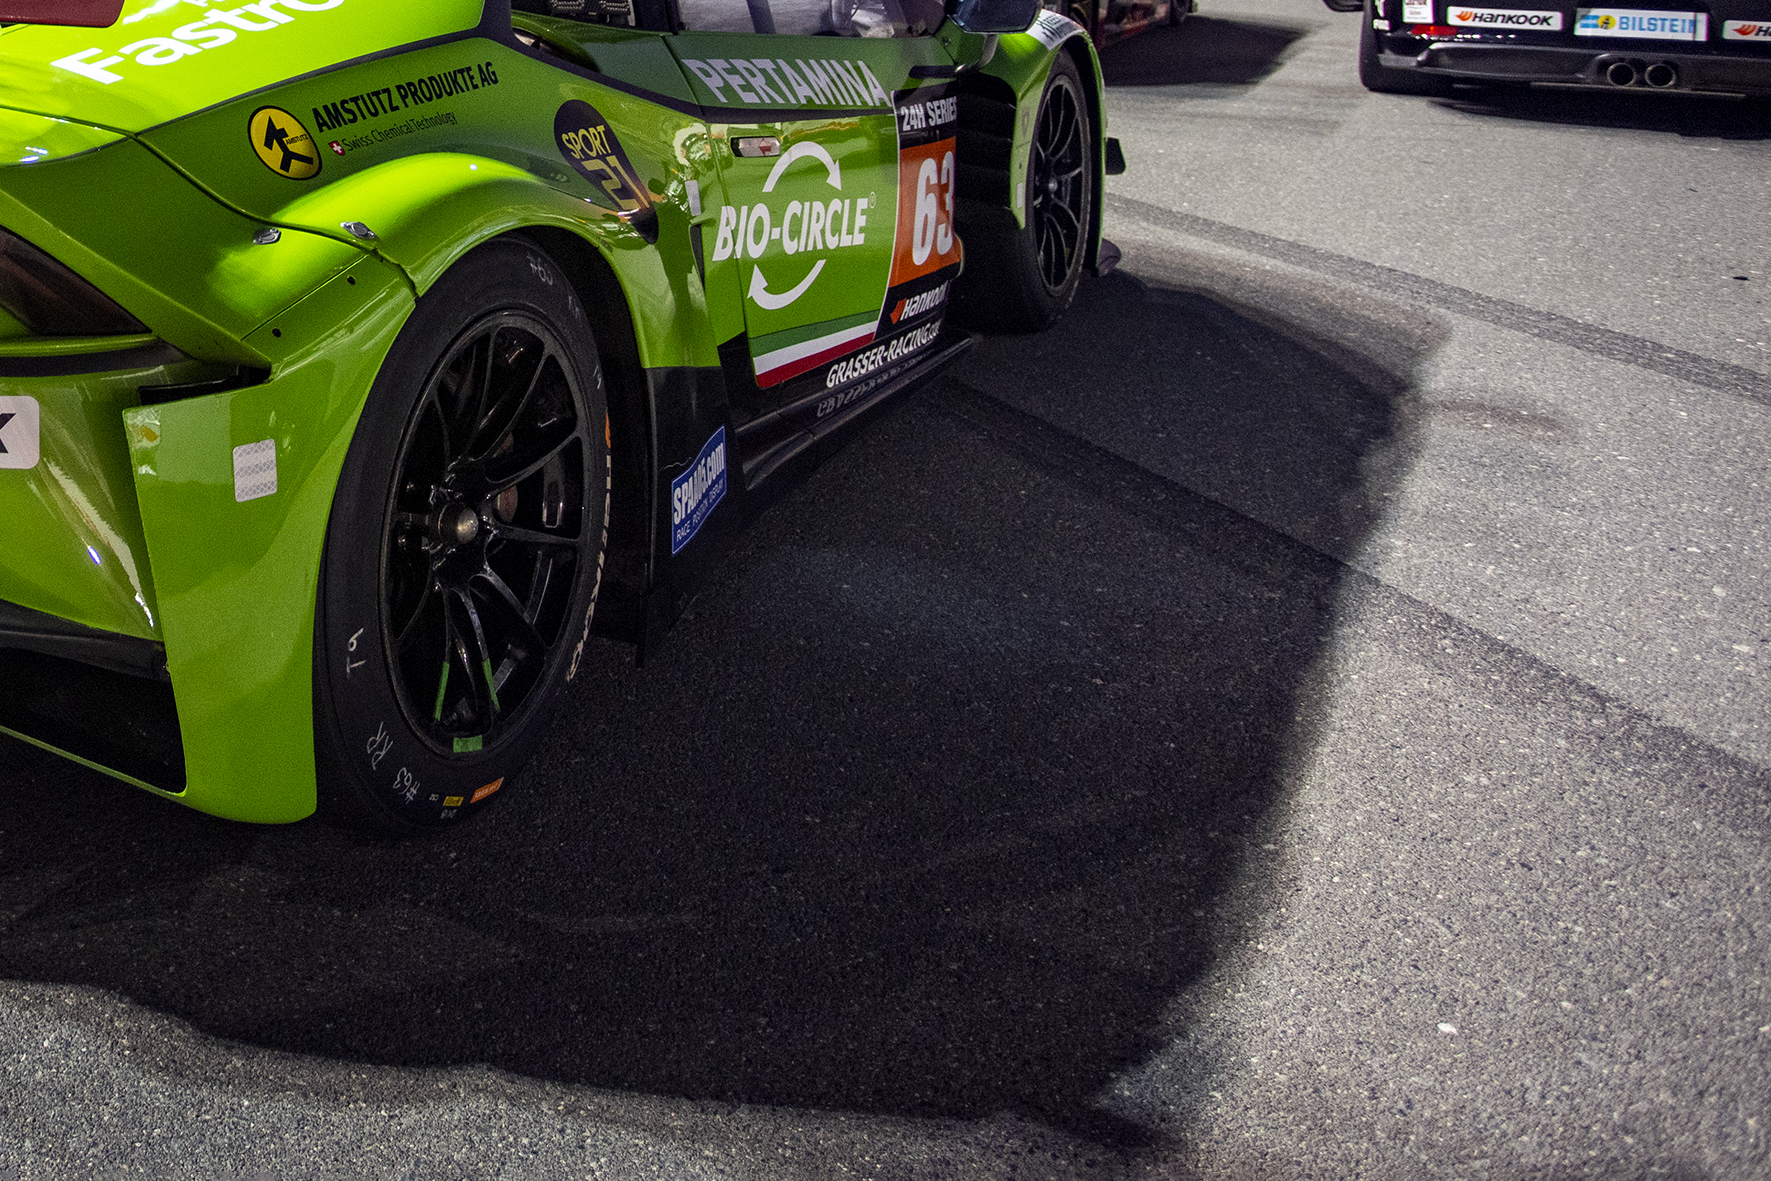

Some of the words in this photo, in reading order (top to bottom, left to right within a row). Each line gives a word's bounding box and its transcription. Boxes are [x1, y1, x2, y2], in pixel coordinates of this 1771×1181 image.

[311, 87, 400, 133] AMSTUTZ
[395, 65, 480, 109] PRODUKTE
[477, 61, 499, 89] AG
[681, 58, 894, 107] PERTAMINA
[341, 134, 374, 153] Swiss
[371, 122, 412, 143] Chemical
[412, 109, 458, 133] Technology
[900, 104, 926, 132] 24H
[561, 124, 613, 161] SPORT
[912, 150, 956, 265] 63
[676, 519, 691, 542] RACE
